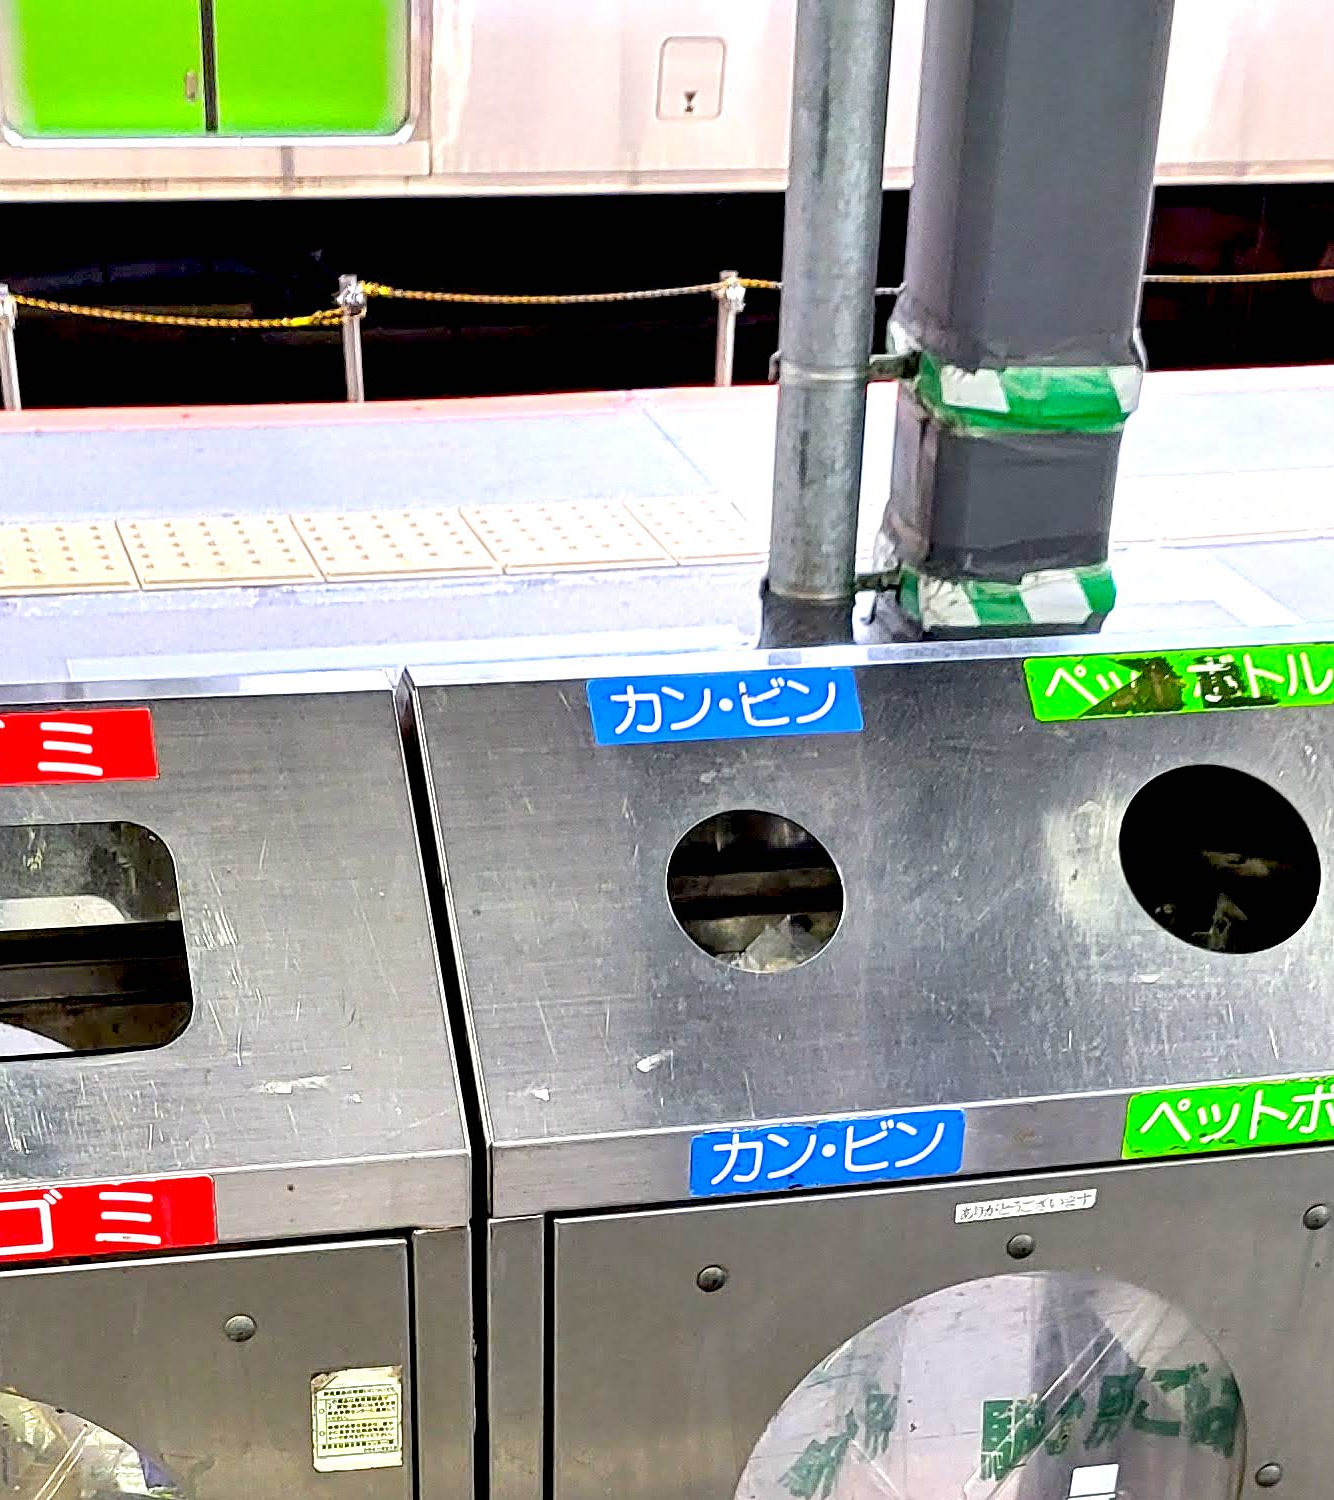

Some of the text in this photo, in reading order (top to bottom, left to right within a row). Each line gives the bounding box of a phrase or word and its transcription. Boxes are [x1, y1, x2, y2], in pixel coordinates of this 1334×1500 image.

[611, 676, 838, 734] カン・ビン
[711, 1121, 946, 1186] カン・ビン
